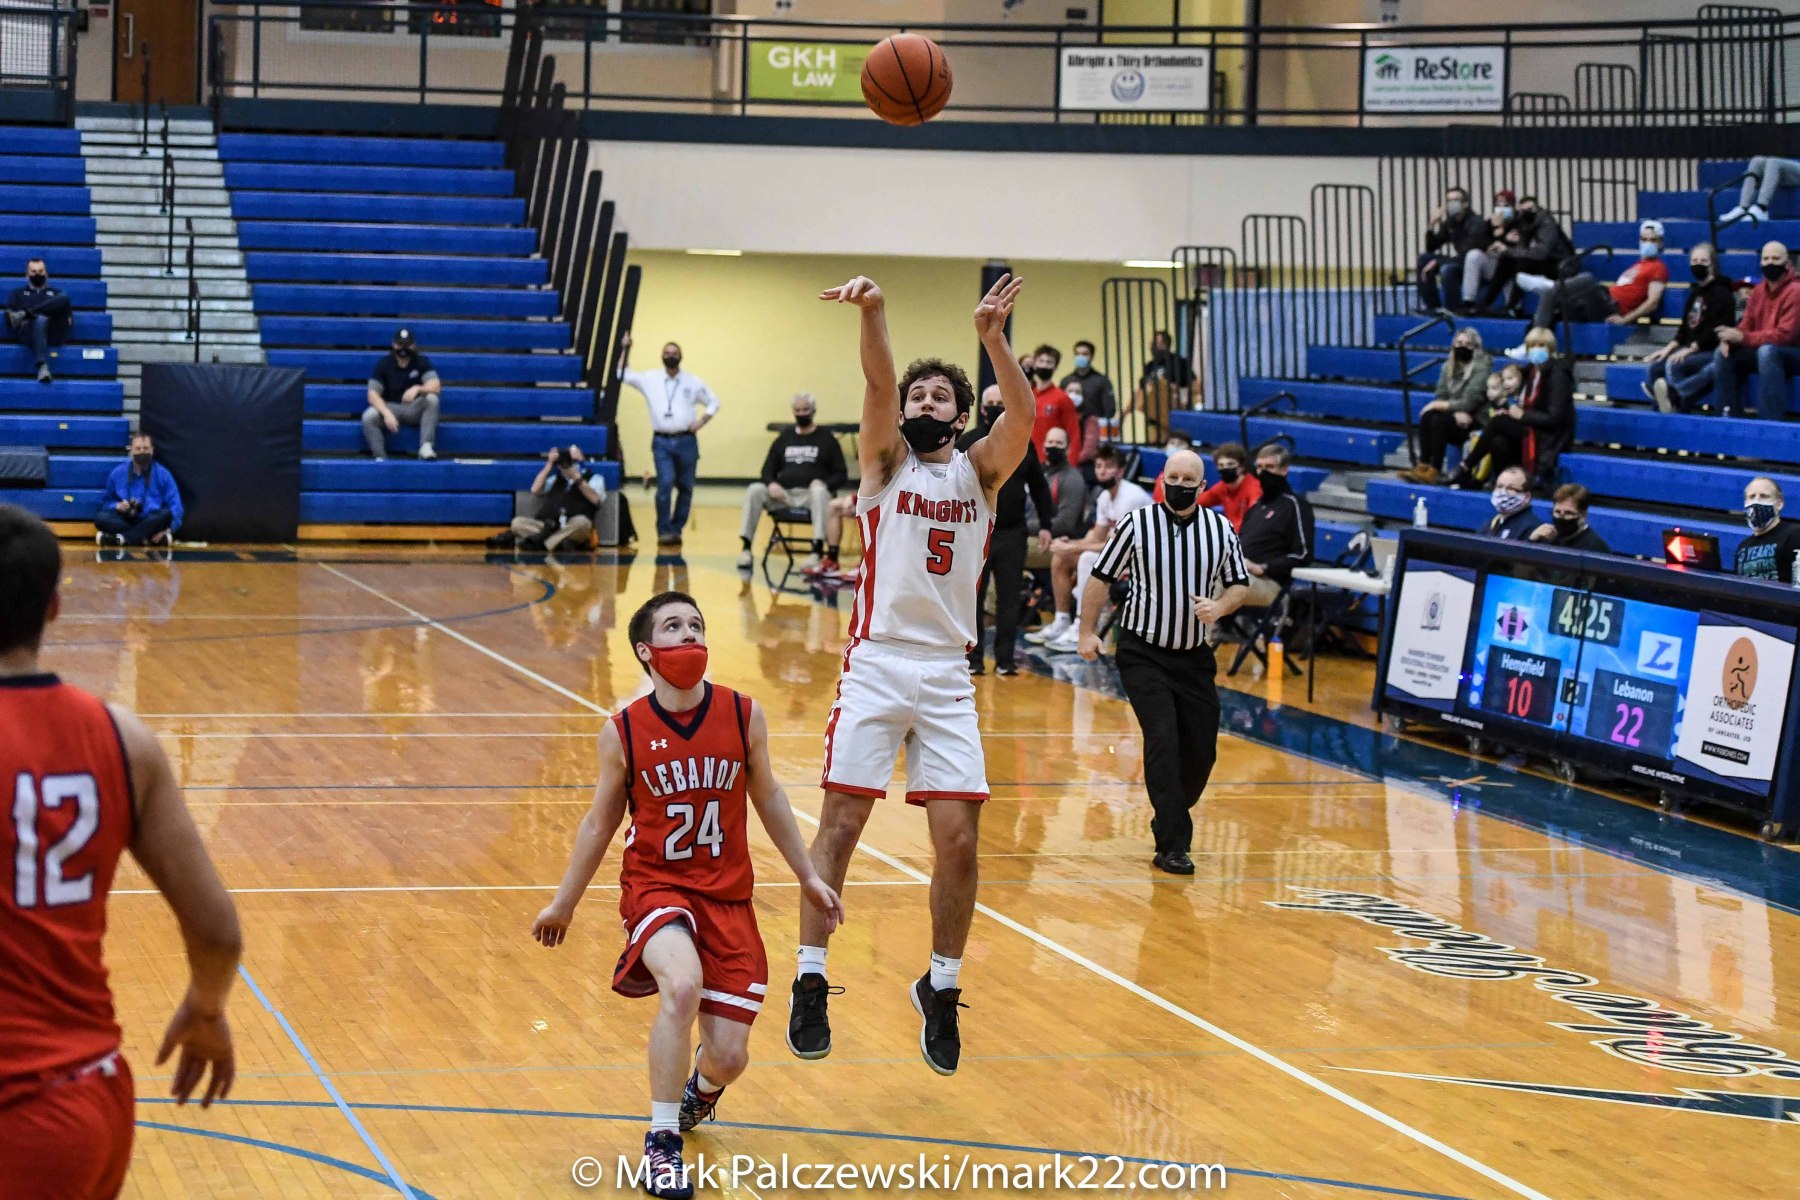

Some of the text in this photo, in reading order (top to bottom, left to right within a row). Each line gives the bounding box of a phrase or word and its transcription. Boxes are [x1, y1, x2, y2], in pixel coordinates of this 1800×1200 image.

[768, 46, 836, 69] GKH
[1144, 54, 1204, 67] Orthodontics
[1414, 56, 1492, 80] ReStore
[792, 71, 836, 87] LAW
[896, 490, 977, 524] KNIGHTS
[926, 527, 955, 576] 5
[1747, 543, 1778, 561] YEARS
[1501, 652, 1547, 678] Hempfield
[1507, 676, 1533, 718] 10
[1613, 678, 1654, 704] Lebanon
[1713, 695, 1757, 716] ORTHOPEDIC
[1611, 703, 1646, 748] 22
[1710, 710, 1754, 731] ASSOCIATES
[640, 756, 741, 798] LEBANON
[13, 772, 99, 907] 12
[665, 799, 724, 860] 24
